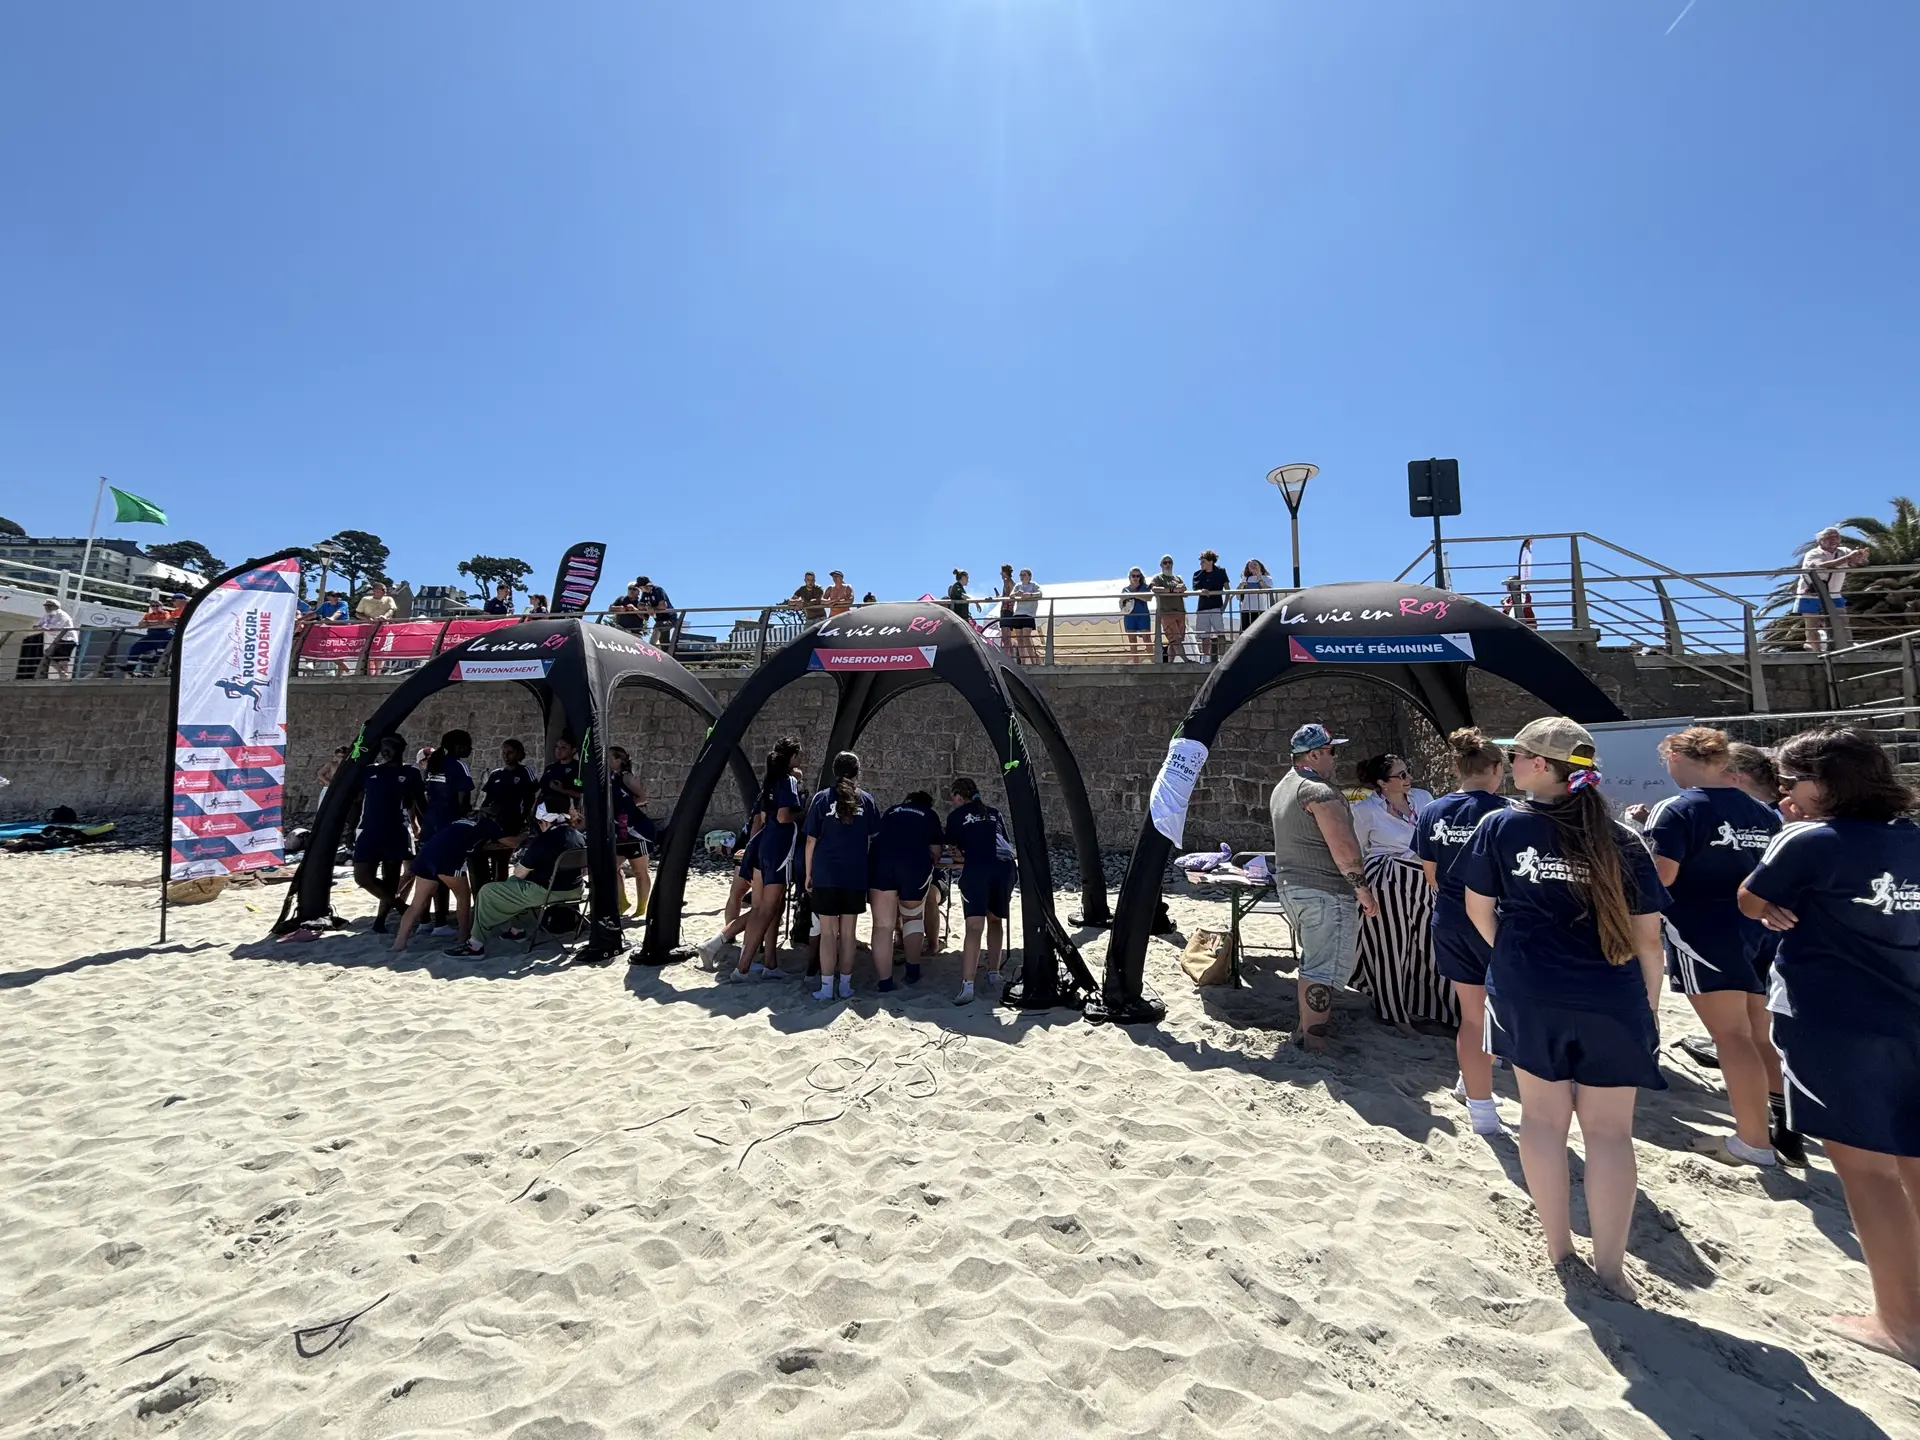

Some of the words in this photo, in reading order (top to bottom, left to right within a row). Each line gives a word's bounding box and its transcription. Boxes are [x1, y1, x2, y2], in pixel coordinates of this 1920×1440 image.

[1280, 605, 1308, 625] La
[1314, 608, 1353, 624] vie
[1360, 608, 1393, 620] en
[1399, 597, 1450, 620] Roz
[816, 619, 840, 637] La
[845, 625, 873, 637] vie
[879, 626, 902, 636] en
[906, 616, 943, 635] Roz
[243, 608, 258, 677] RUGBYGIRL
[256, 612, 271, 676] ACADÉMIE
[466, 637, 489, 651] La
[491, 641, 518, 652] vie
[518, 642, 538, 651] en
[589, 633, 607, 649] La
[1315, 643, 1364, 654] SANTÉ
[1368, 643, 1444, 654] FÉMININE
[830, 655, 888, 664] INSERTION
[890, 655, 913, 663] PRO
[465, 665, 539, 674] ENVIRONNEMENT
[1170, 753, 1187, 762] pts
[1172, 761, 1196, 777] Trégor
